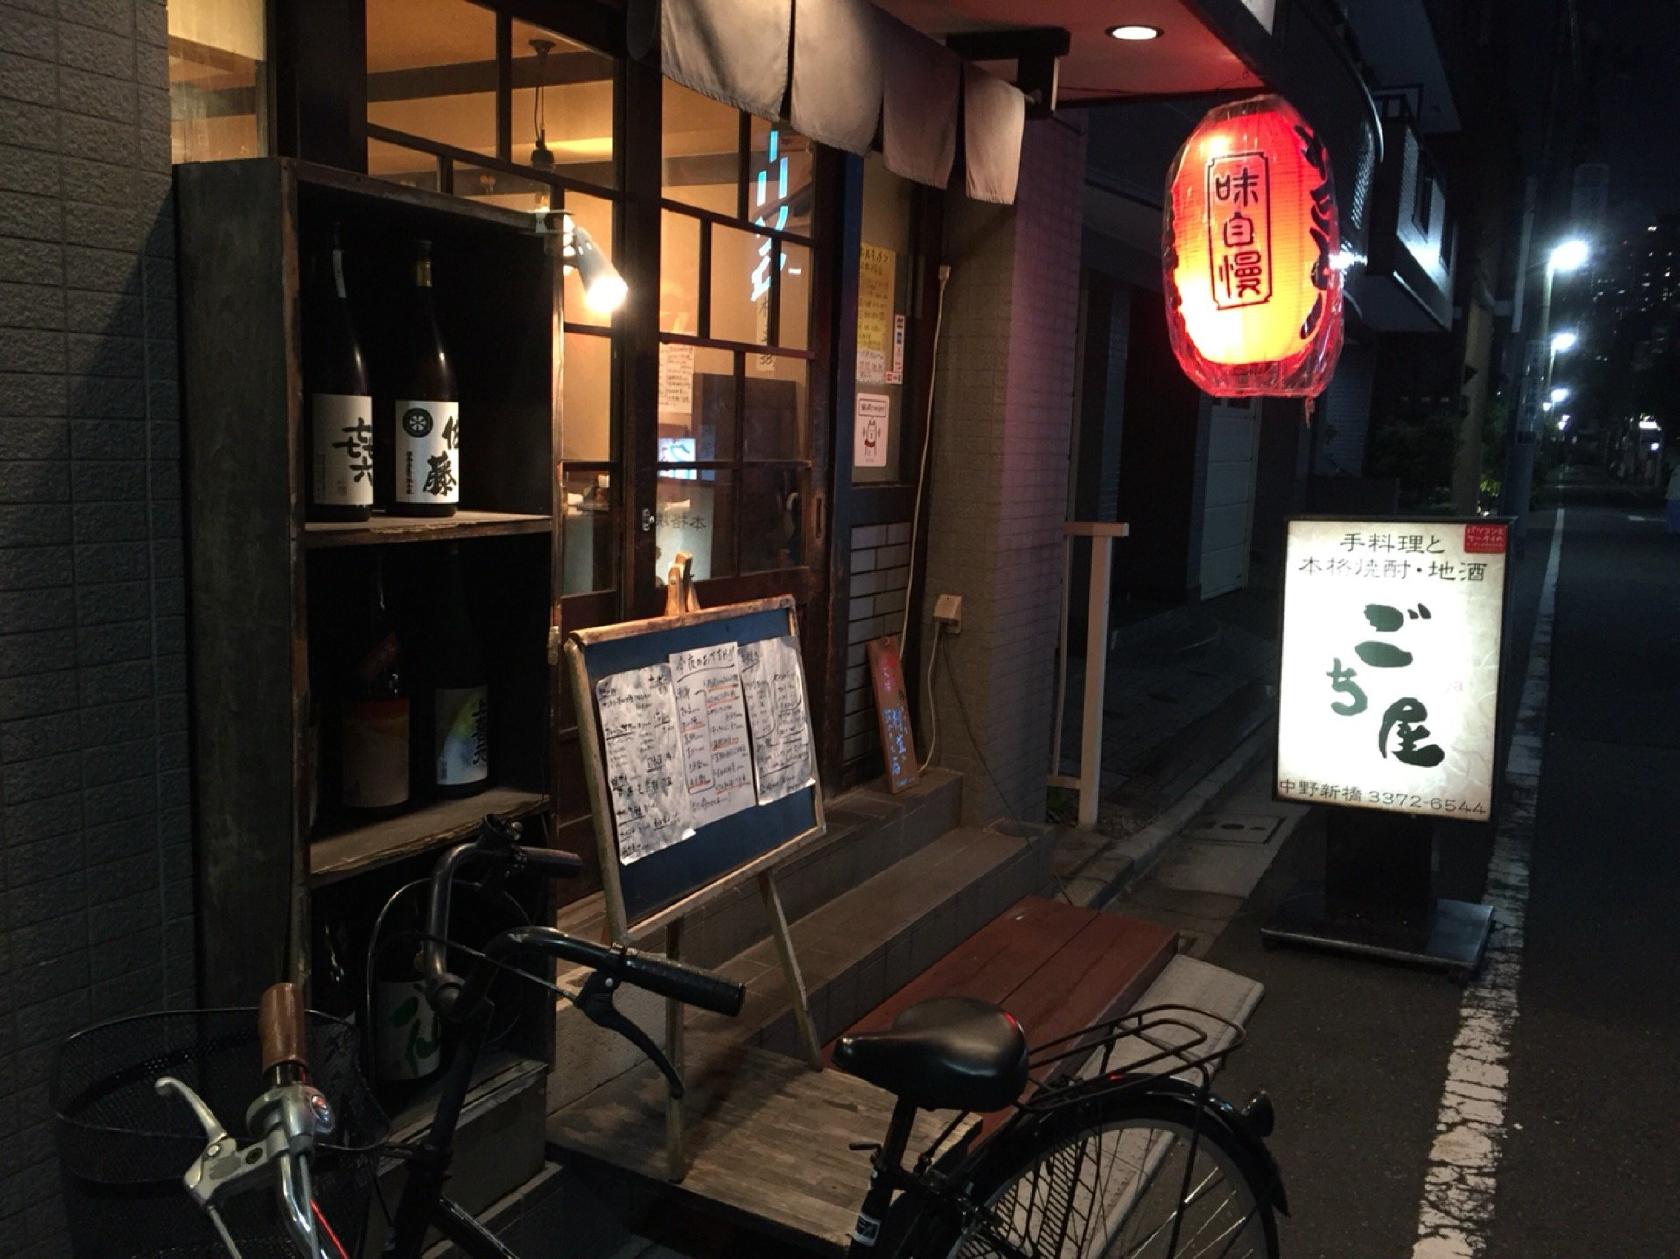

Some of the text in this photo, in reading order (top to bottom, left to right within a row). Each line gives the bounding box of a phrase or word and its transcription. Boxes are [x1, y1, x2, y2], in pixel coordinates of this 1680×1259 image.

[1214, 167, 1263, 299] 味自慢
[1339, 532, 1446, 554] 手料理と
[1279, 779, 1488, 816] 中野新橋 3372-6544
